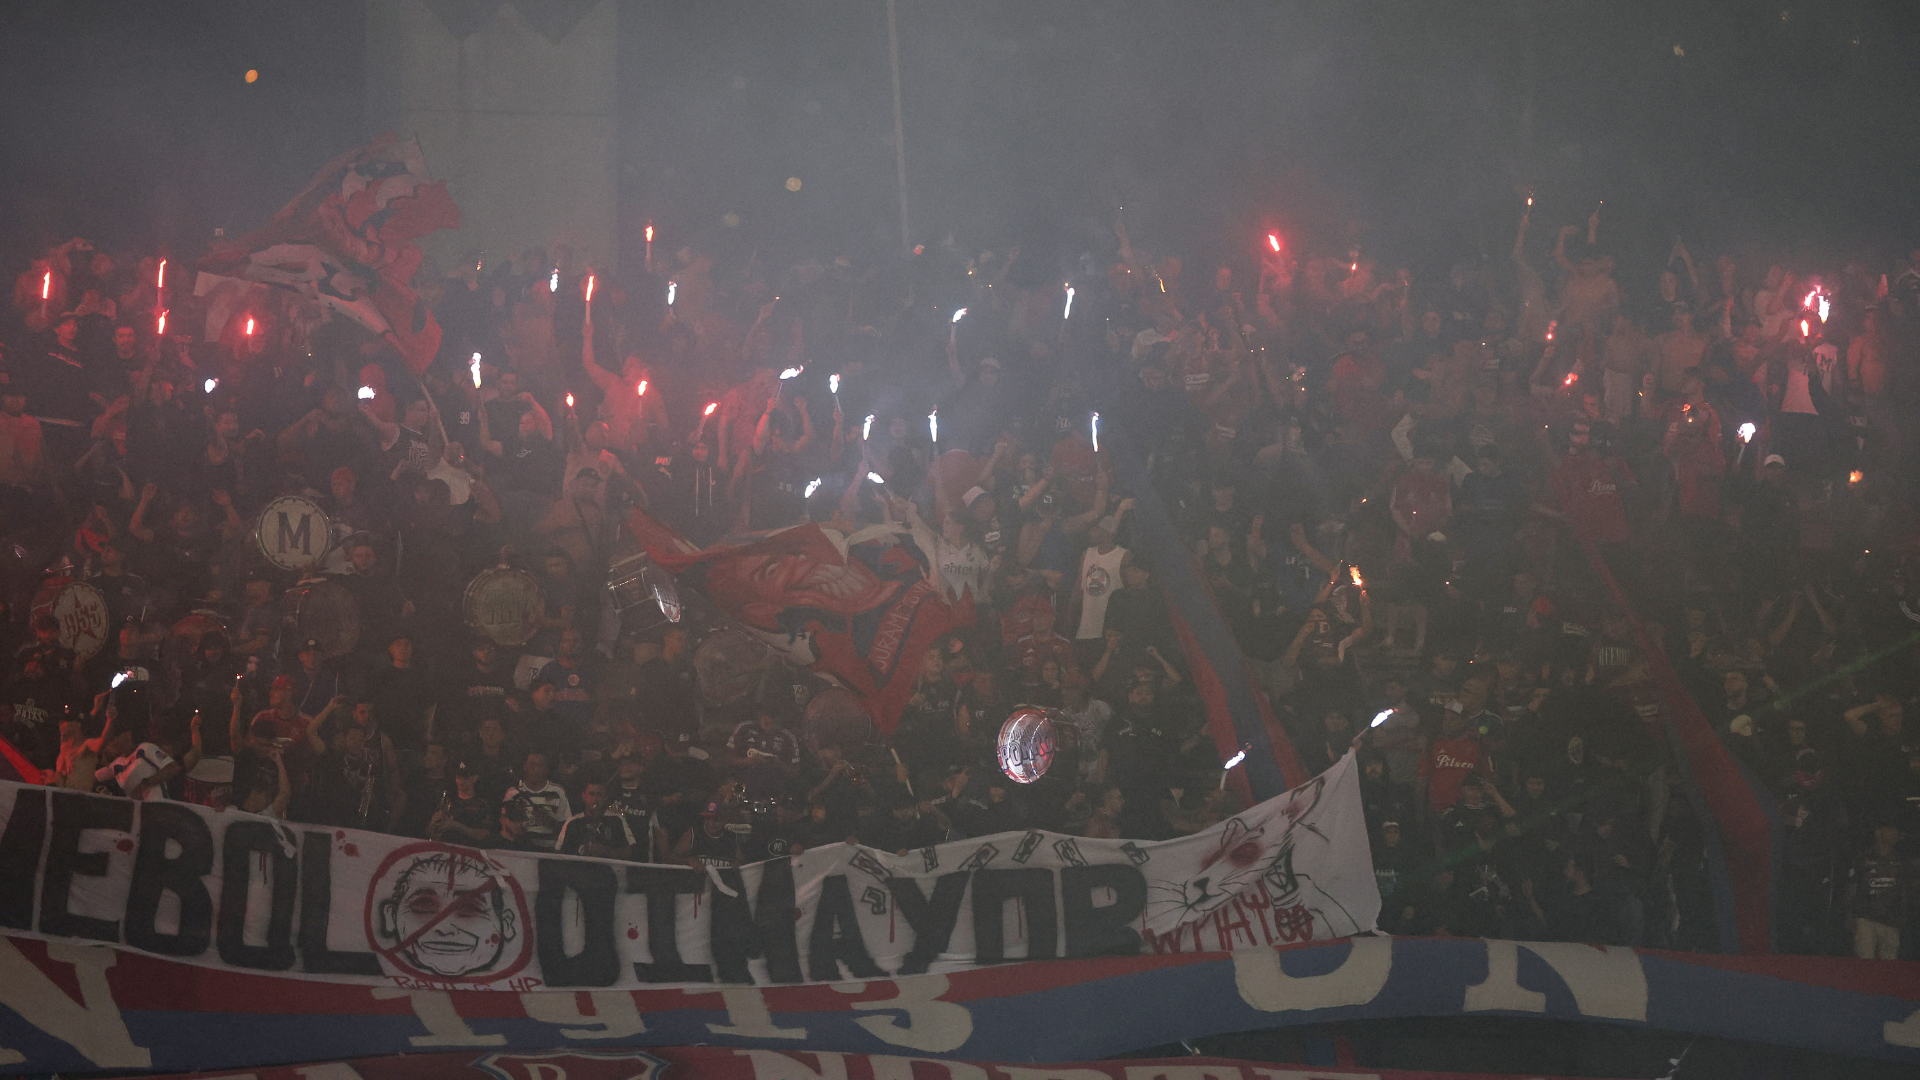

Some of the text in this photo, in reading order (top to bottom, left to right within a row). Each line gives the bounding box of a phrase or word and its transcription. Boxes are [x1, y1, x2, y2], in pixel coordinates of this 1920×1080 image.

[276, 511, 313, 556] M
[943, 562, 973, 575] antel
[63, 601, 101, 639] 1955
[1436, 754, 1475, 769] Pilsen
[534, 854, 1150, 988] DIMAYOR
[508, 976, 543, 993] HP
